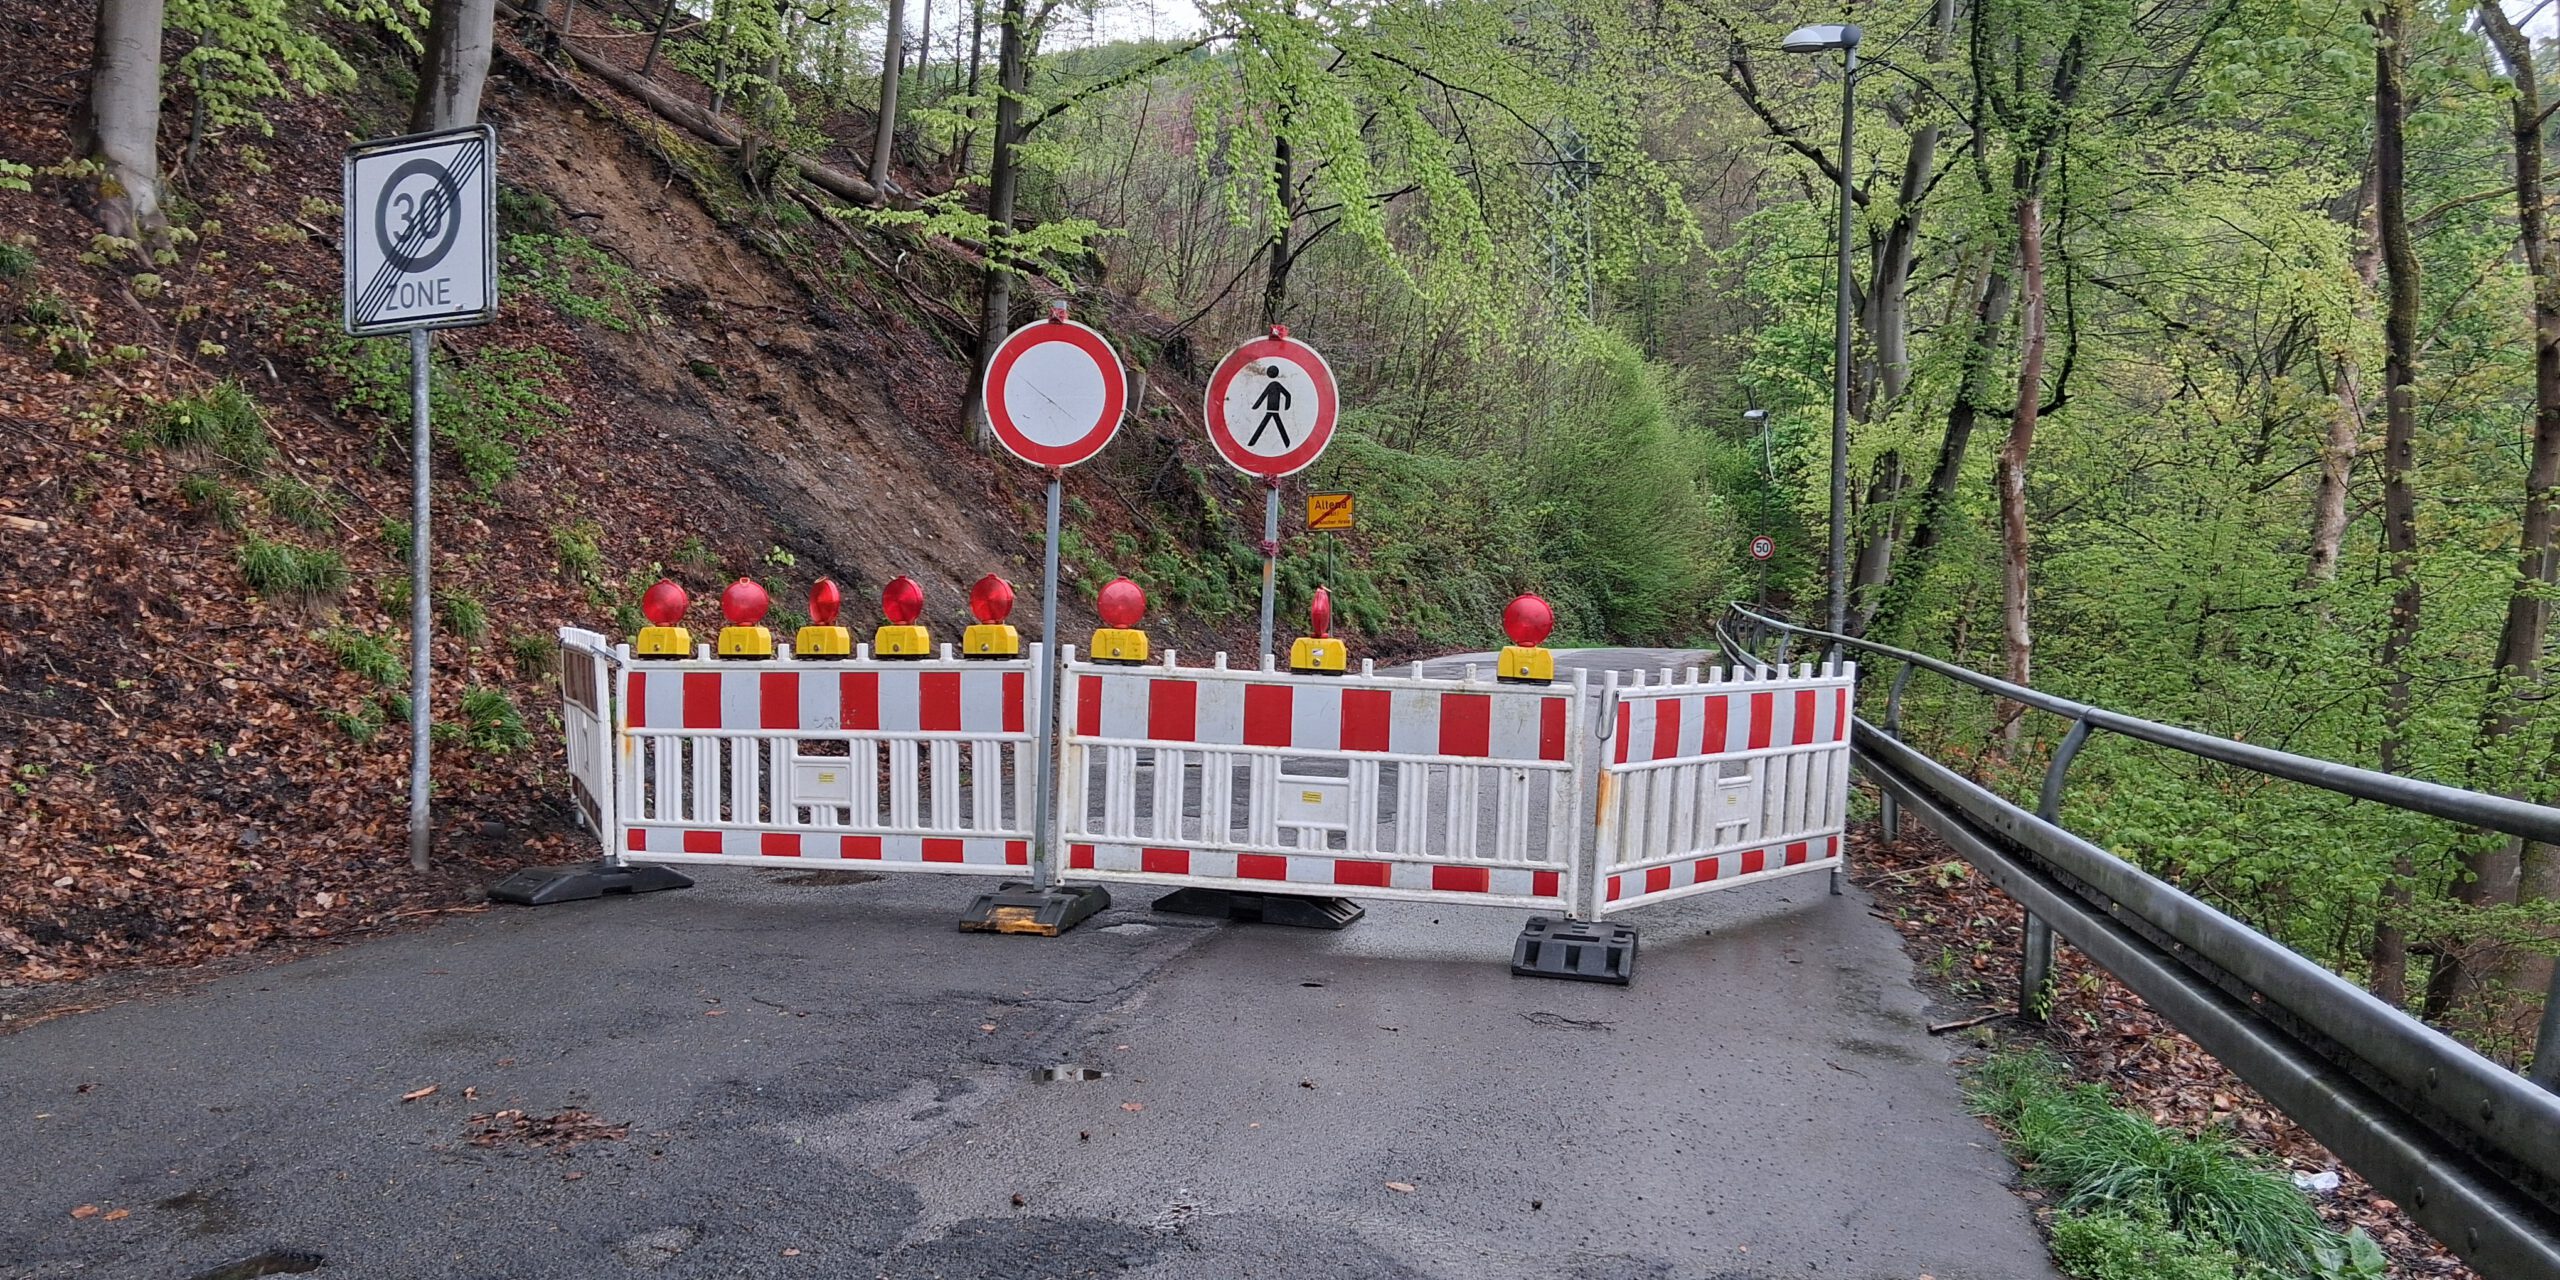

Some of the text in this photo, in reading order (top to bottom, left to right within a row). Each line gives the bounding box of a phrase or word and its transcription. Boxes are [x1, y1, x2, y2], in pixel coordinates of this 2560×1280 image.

[393, 189, 442, 243] 30
[385, 277, 451, 311] ZONE
[1756, 542, 1769, 553] 50
